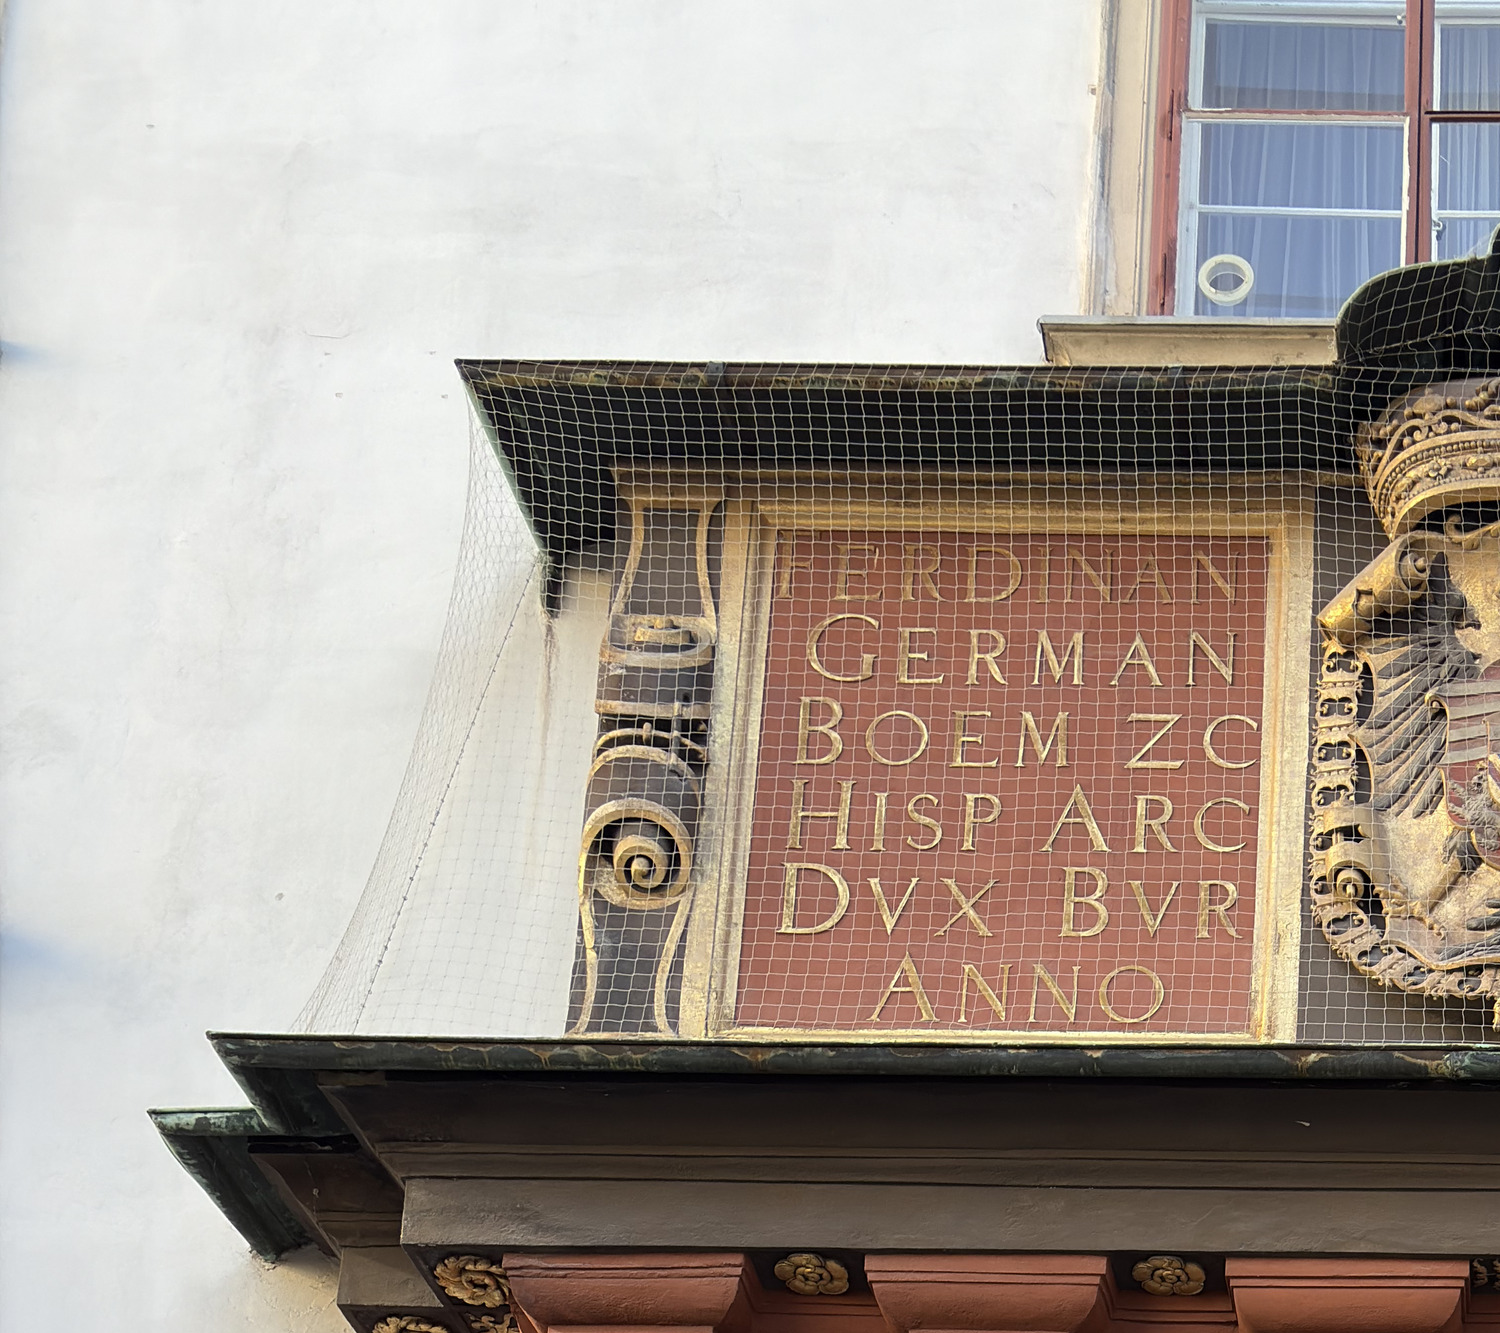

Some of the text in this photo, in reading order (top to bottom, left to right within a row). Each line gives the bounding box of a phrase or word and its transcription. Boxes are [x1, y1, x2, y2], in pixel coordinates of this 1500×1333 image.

[775, 530, 1240, 604] FERDINAN
[805, 613, 1239, 687] GERMAN
[793, 696, 1071, 768] BOEM
[784, 779, 1251, 853] HISP ARC
[776, 862, 1243, 939] DVX BVR
[866, 951, 1164, 1023] ANNO
